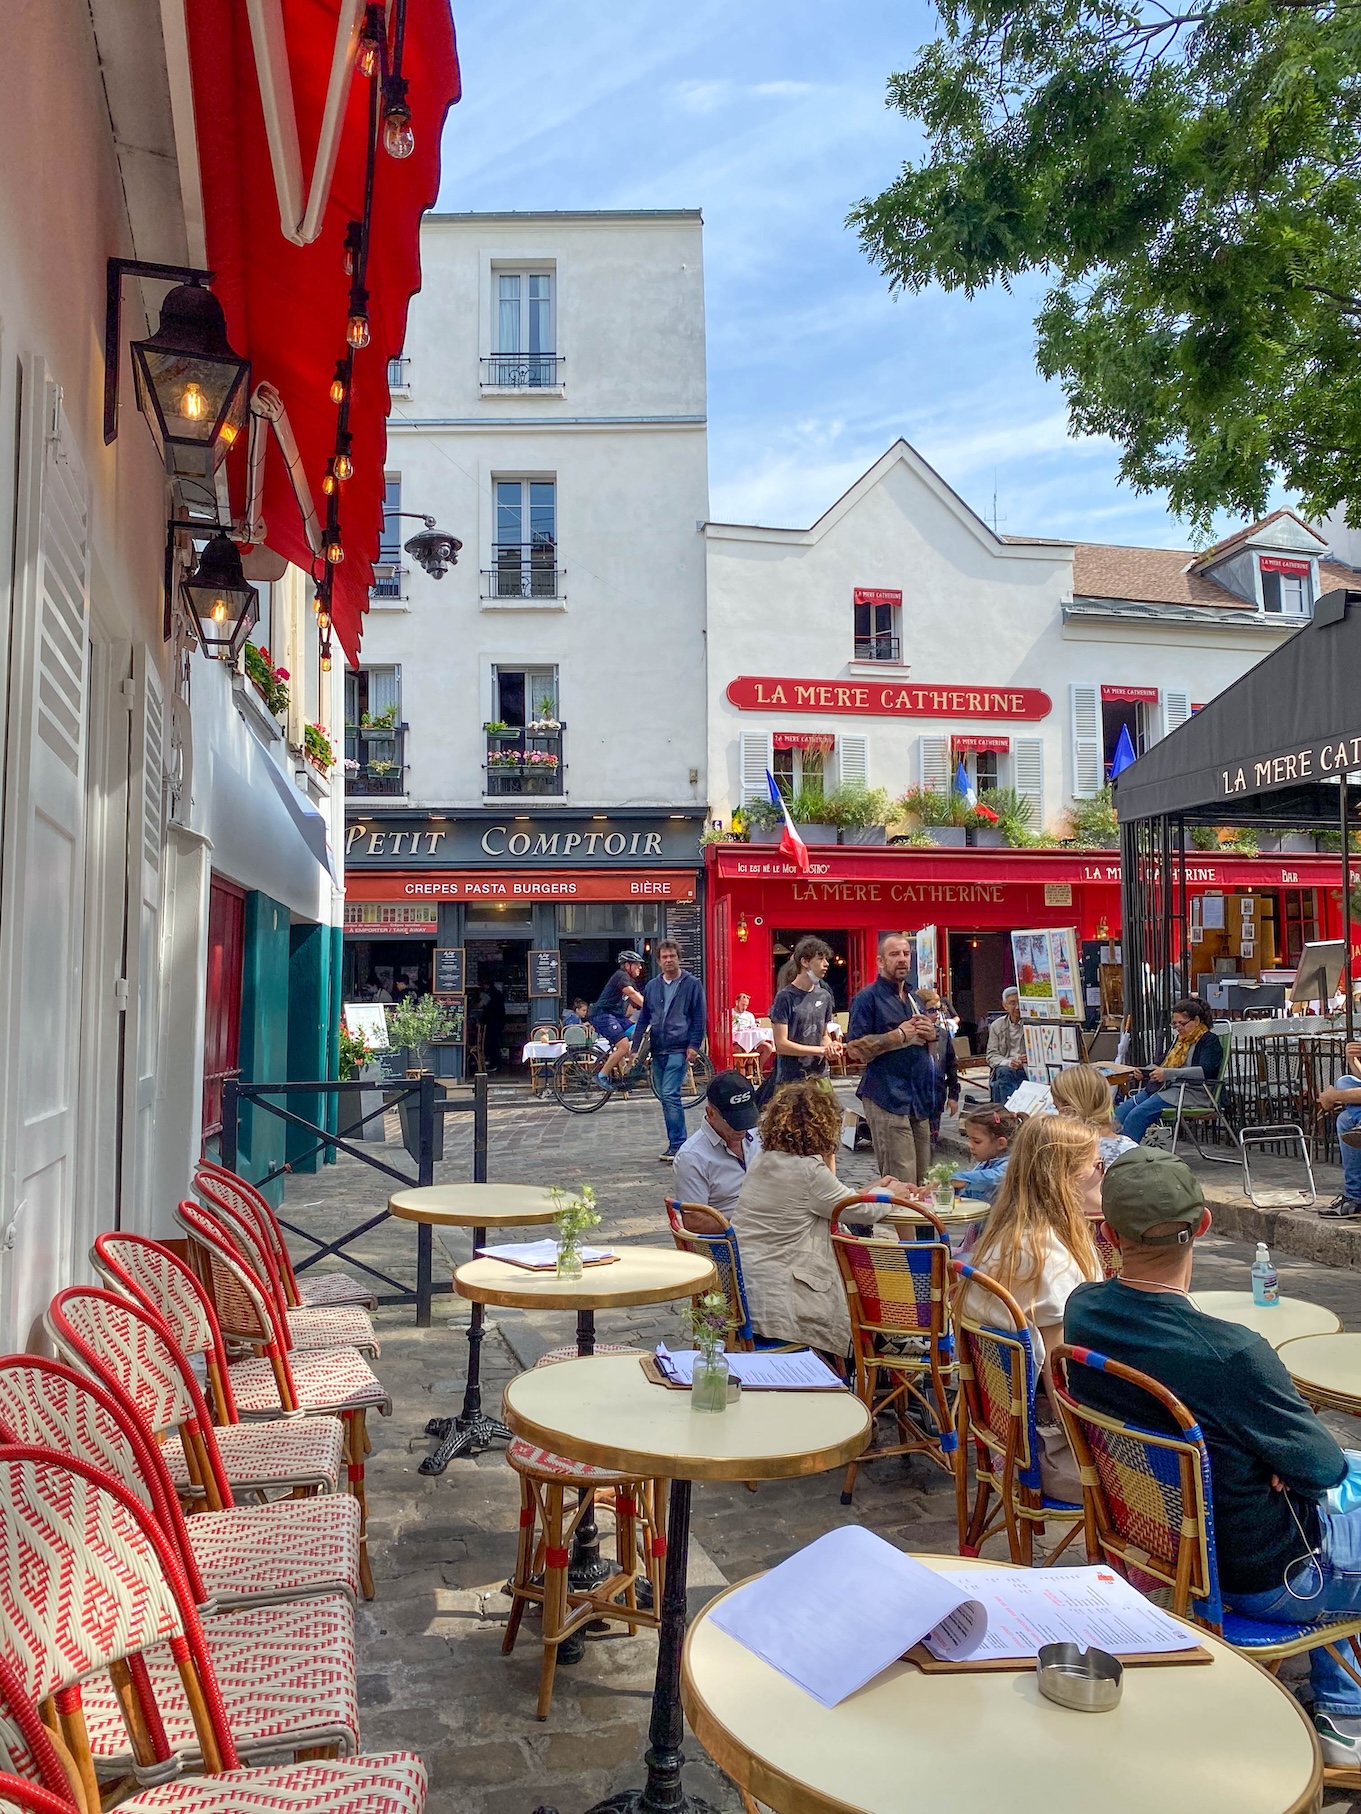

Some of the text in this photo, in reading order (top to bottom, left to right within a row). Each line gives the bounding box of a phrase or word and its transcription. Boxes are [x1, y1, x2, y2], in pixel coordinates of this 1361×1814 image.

[754, 684, 1026, 713] LA MERE CATHERINE
[1127, 689, 1156, 697] CATHERINE
[1223, 767, 1247, 795] LA
[1254, 750, 1313, 787] MERE
[345, 825, 663, 856] PETIT COMPTOIR
[1085, 867, 1101, 880] LA
[405, 883, 577, 894] CREPES PASTA BURGERS
[630, 880, 671, 894] BIÈRE
[792, 884, 1004, 902] LA MERE CATHERINE
[729, 1091, 751, 1105] GS
